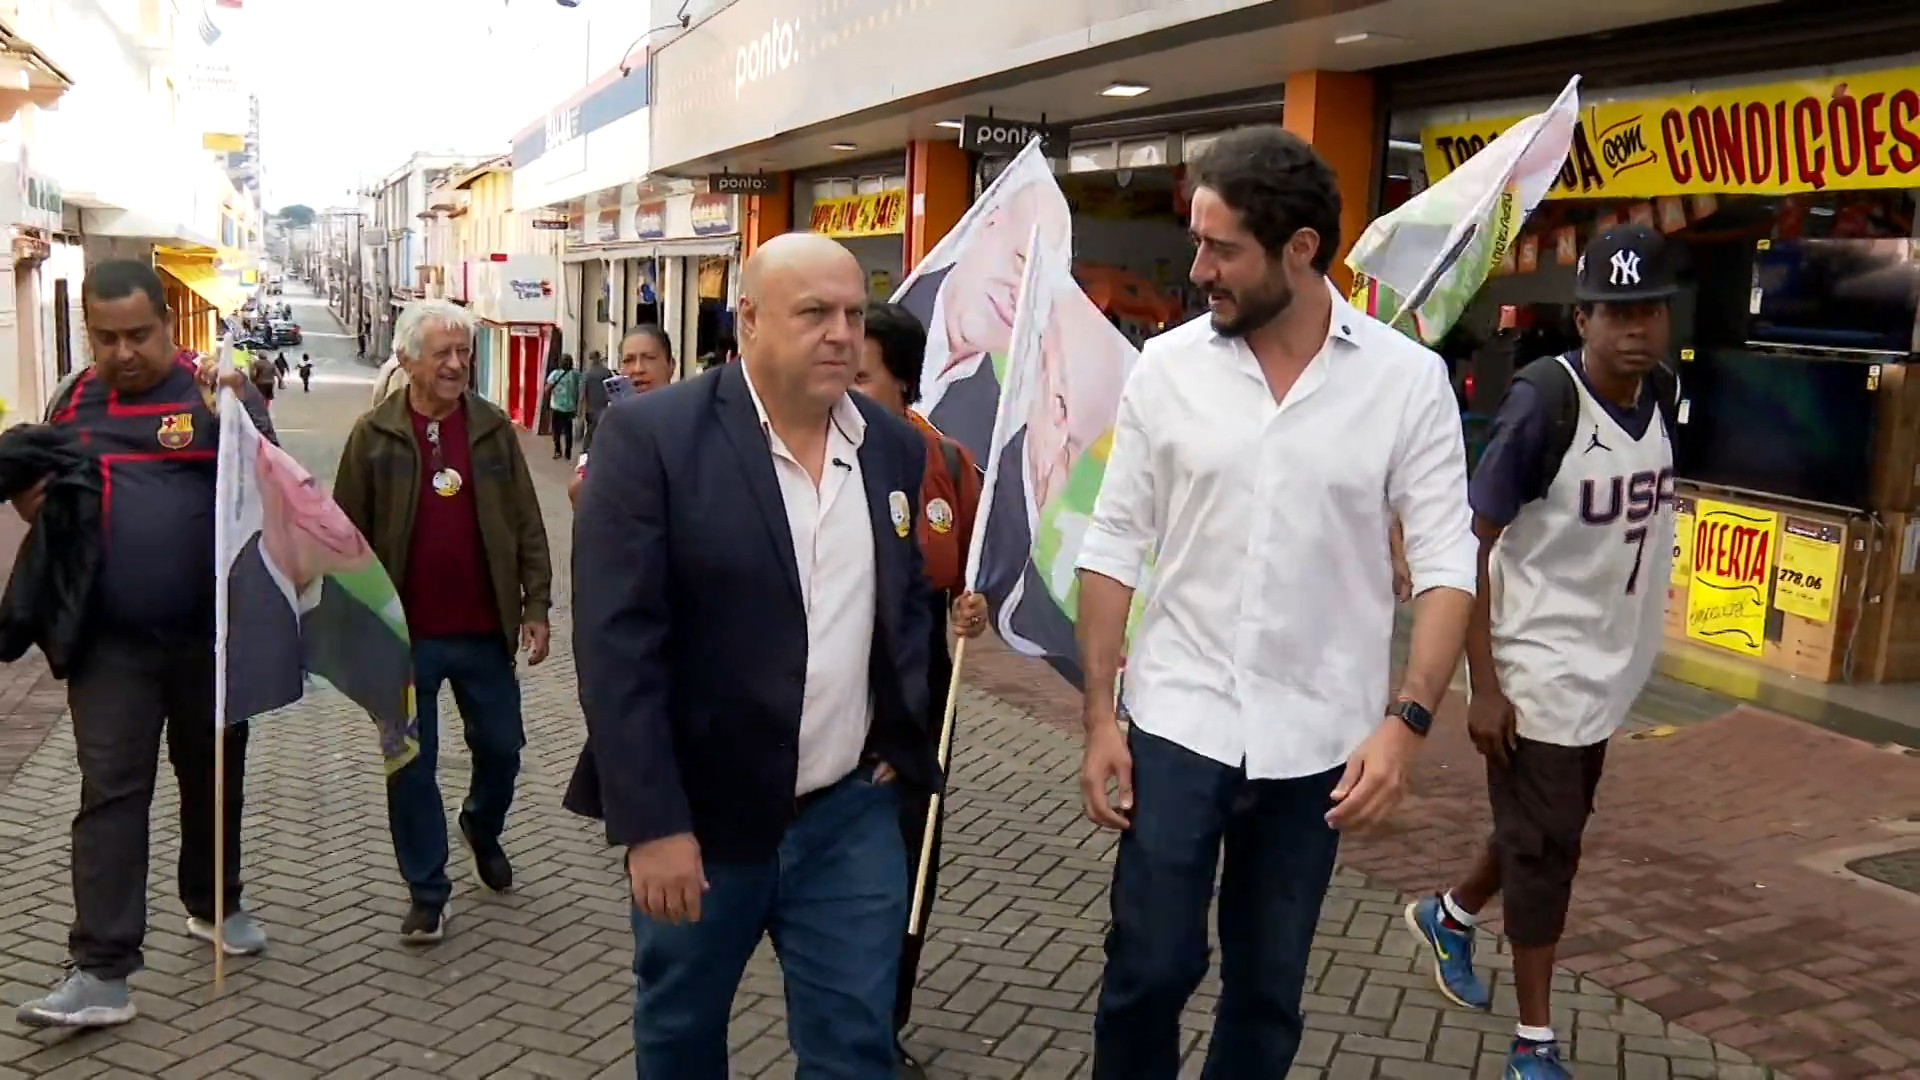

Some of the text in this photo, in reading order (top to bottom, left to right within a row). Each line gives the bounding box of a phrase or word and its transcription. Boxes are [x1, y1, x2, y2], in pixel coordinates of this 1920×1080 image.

[735, 17, 800, 101] ponto:
[718, 177, 768, 191] ponto:
[1609, 249, 1642, 286] NY
[1623, 526, 1648, 596] 7
[1695, 519, 1770, 586] OFERTA
